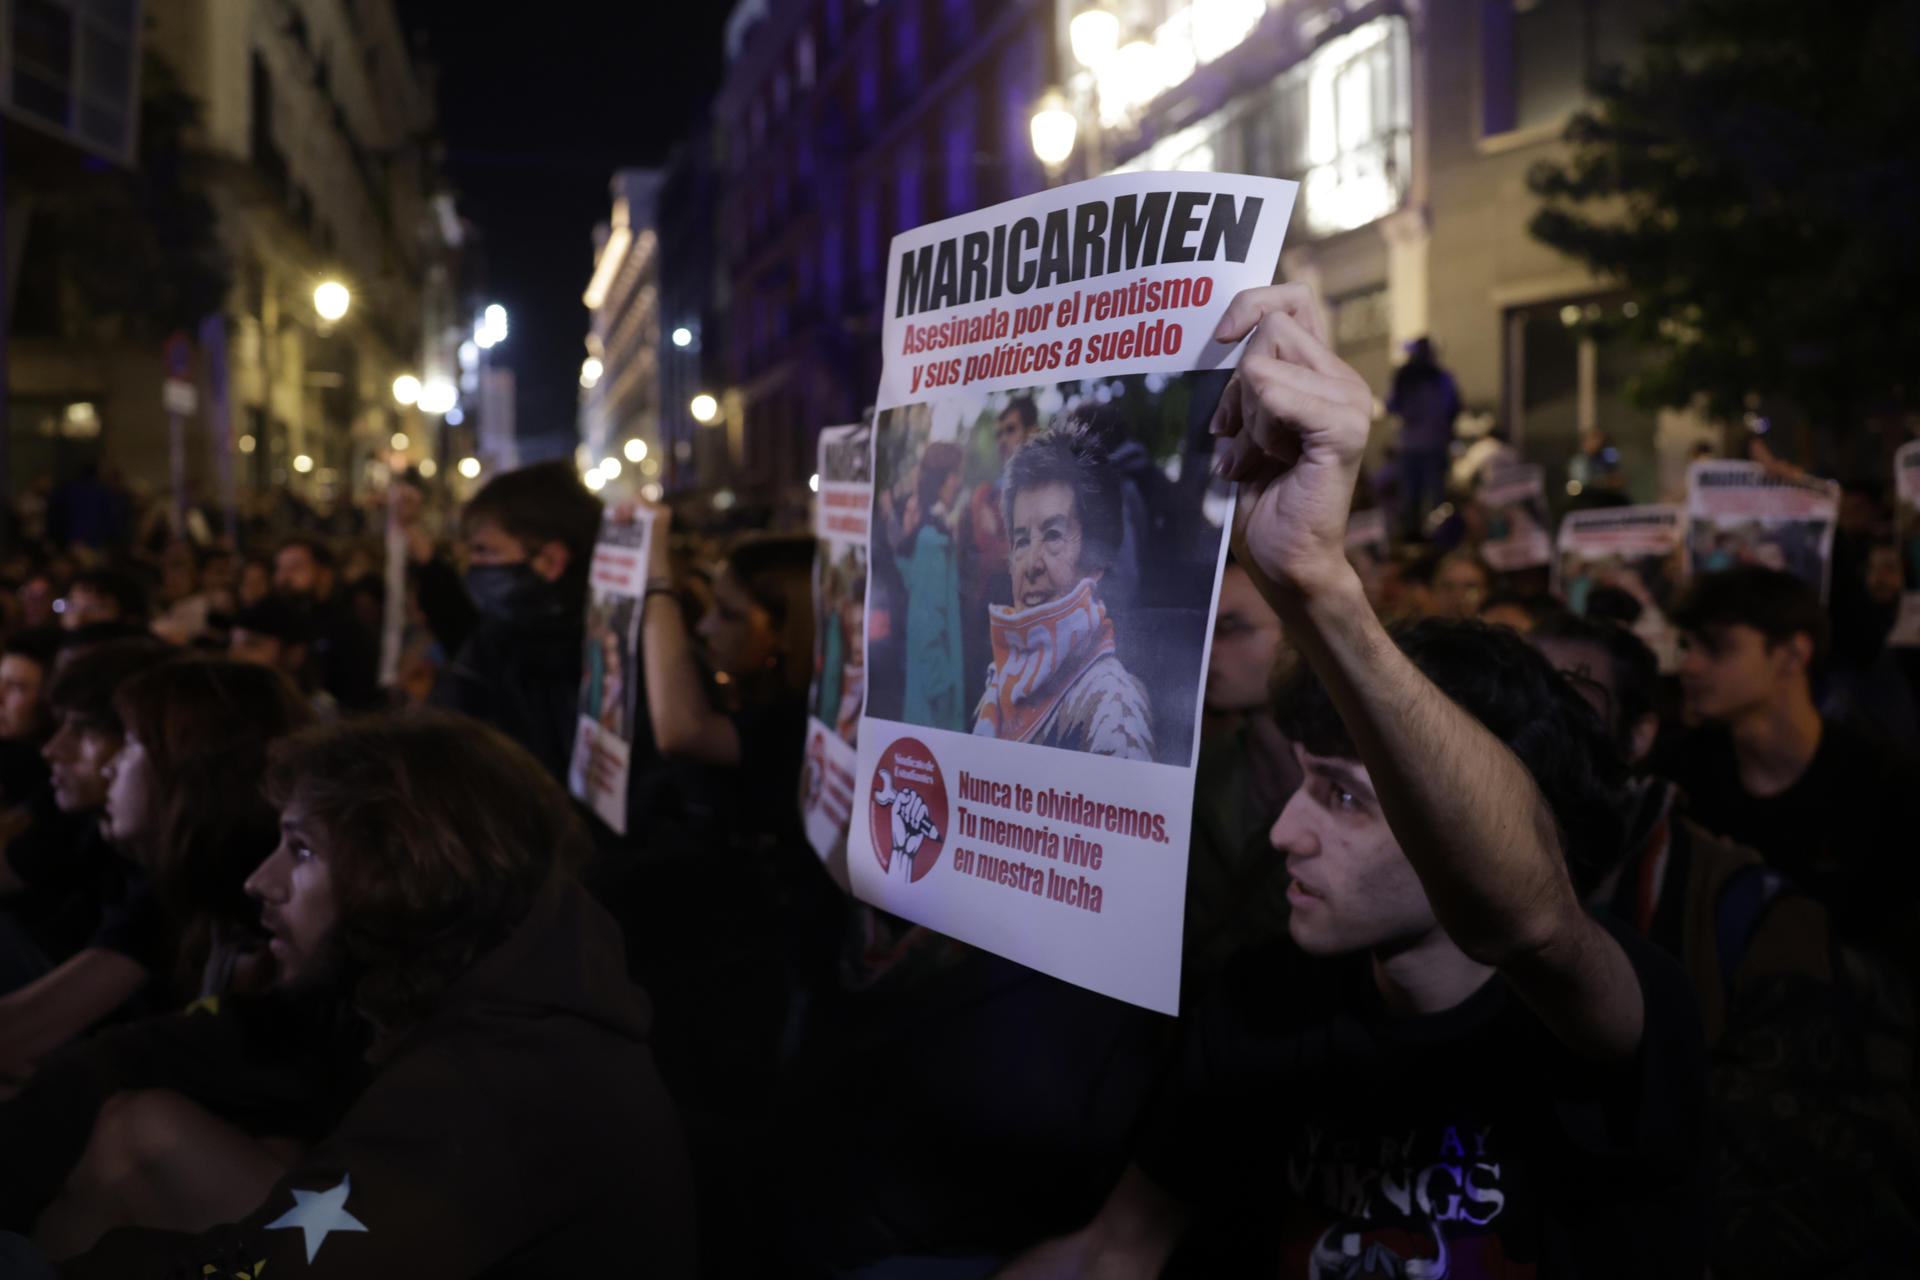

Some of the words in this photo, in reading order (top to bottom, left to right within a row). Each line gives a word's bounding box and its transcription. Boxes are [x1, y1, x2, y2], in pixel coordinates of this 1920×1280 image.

[896, 191, 1264, 319] MARICARMEN
[902, 308, 1010, 356] Asesinada
[1012, 301, 1054, 340] por
[1056, 290, 1081, 328] el
[1083, 277, 1214, 324] rentismo
[910, 364, 924, 394] y
[924, 357, 962, 388] sus
[962, 341, 1063, 386] políticos
[1065, 337, 1083, 367] a
[1085, 319, 1183, 365] sueldo
[958, 806, 977, 838] Tu
[979, 815, 1060, 859] memoria
[1063, 833, 1104, 871] vive
[959, 770, 1012, 809] Nunca
[1015, 783, 1033, 814] te
[1036, 788, 1170, 844] olvidaremos.
[953, 847, 976, 875] en
[976, 853, 1044, 896] nuestra
[1046, 868, 1104, 914] lucha
